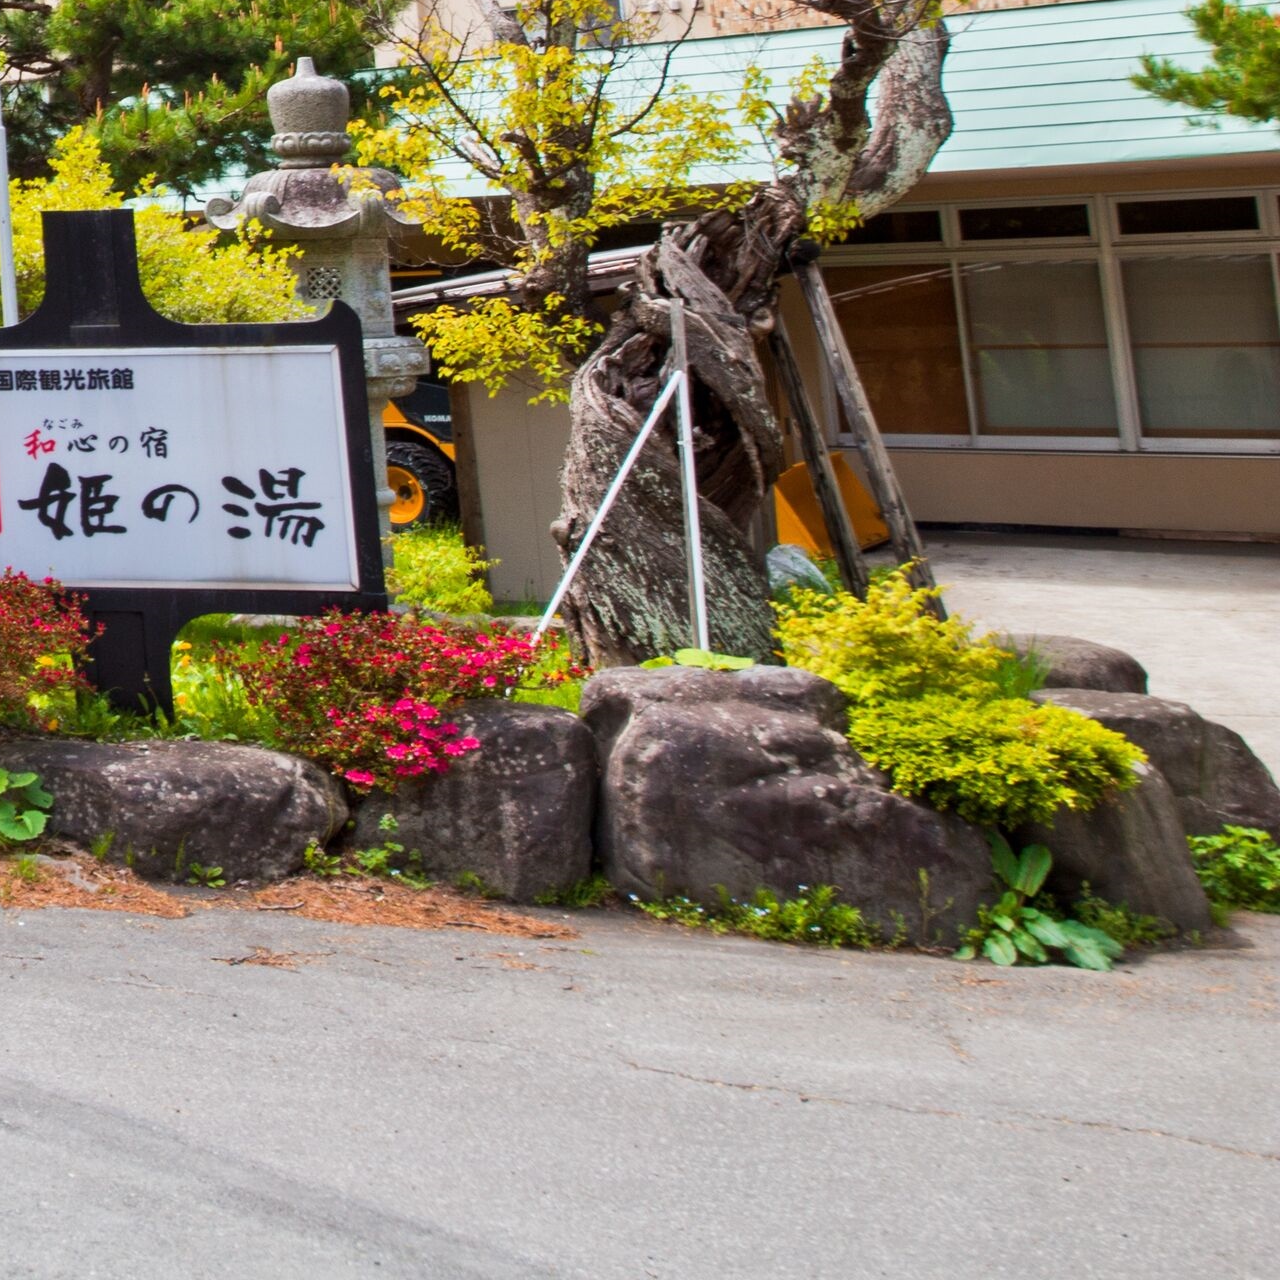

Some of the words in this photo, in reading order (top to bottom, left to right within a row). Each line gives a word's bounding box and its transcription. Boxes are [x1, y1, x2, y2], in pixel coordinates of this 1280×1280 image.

[23, 426, 169, 460] 和心の宿
[17, 462, 326, 547] 姫の湯
